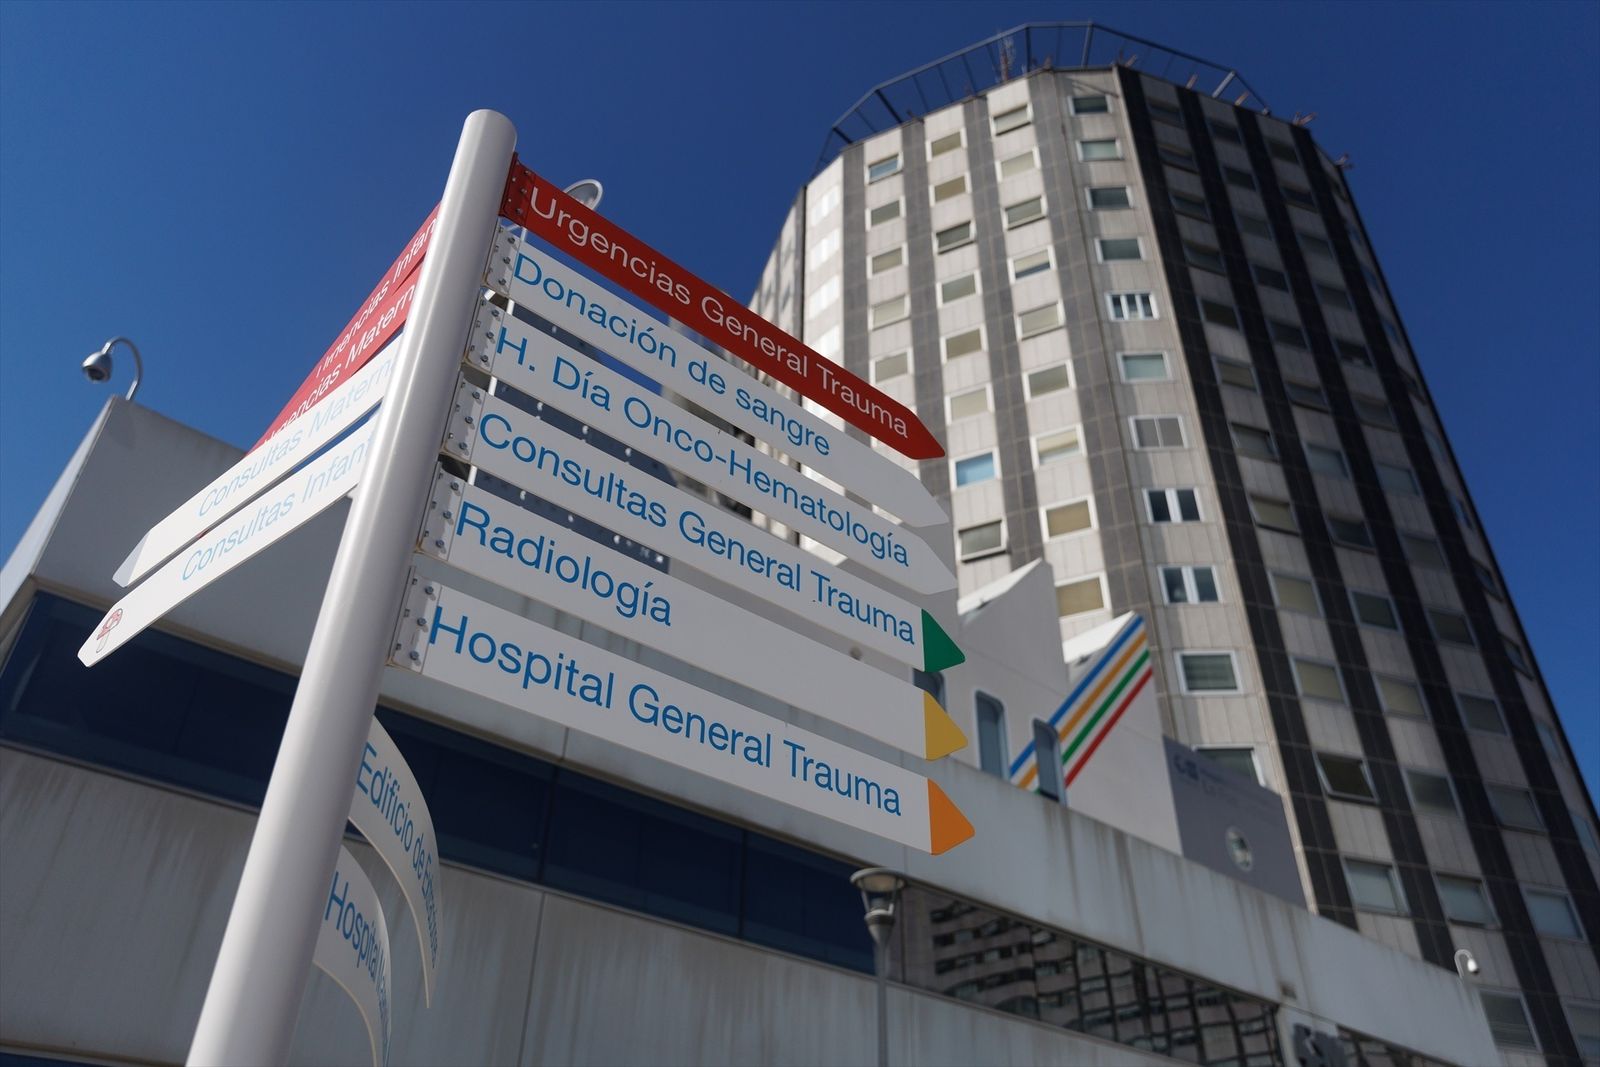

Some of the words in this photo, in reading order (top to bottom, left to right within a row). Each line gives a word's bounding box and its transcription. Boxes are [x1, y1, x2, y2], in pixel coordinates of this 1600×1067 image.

[514, 253, 676, 367] Donación
[687, 361, 726, 395] de
[736, 389, 831, 455] sangre
[530, 186, 691, 305] Urgencias
[701, 296, 807, 378] General
[817, 363, 908, 439] Trauma
[199, 429, 303, 517] Consultas
[308, 359, 393, 438] Matern
[496, 327, 536, 371] H.
[553, 357, 612, 411] Día
[624, 396, 909, 566] Onco-Hematología
[182, 492, 296, 580] Consultas
[455, 501, 671, 626] Radiología
[479, 413, 667, 528] Consultas
[678, 511, 801, 592] General
[811, 571, 915, 645] Trauma
[428, 607, 614, 709] Hospital
[628, 684, 772, 768] General
[784, 740, 901, 816] Trauma
[356, 742, 414, 853] Edificio
[413, 832, 425, 880] de
[325, 871, 382, 990] Hospital
